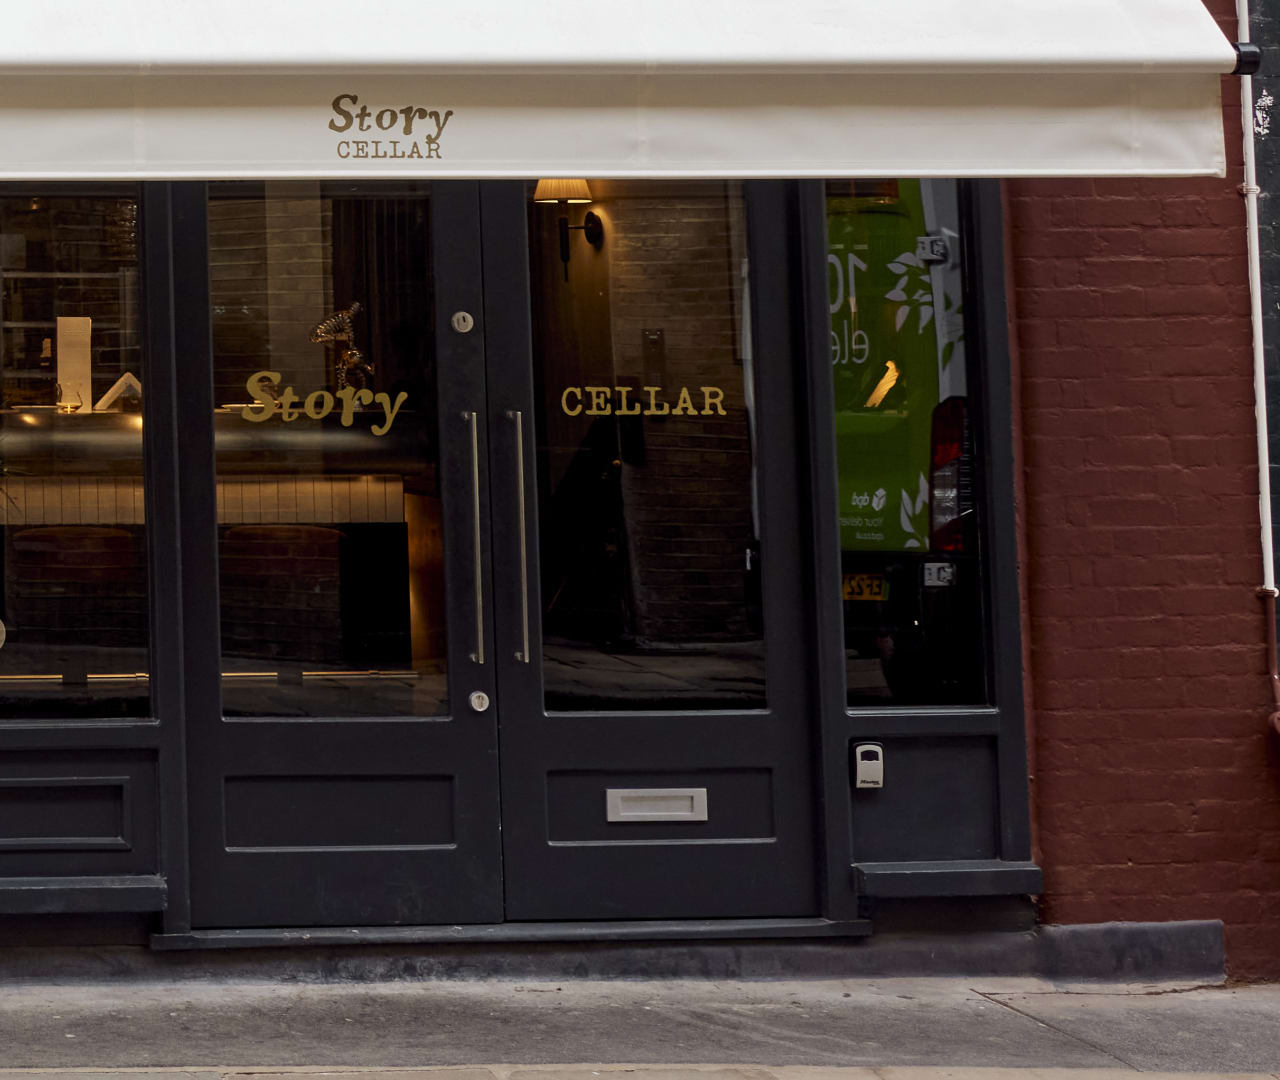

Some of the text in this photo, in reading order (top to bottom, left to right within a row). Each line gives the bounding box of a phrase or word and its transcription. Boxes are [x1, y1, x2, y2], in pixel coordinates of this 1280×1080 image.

[328, 94, 453, 143] Story
[337, 140, 442, 159] CELLAR
[241, 370, 408, 436] Story
[561, 386, 727, 416] CELLAR
